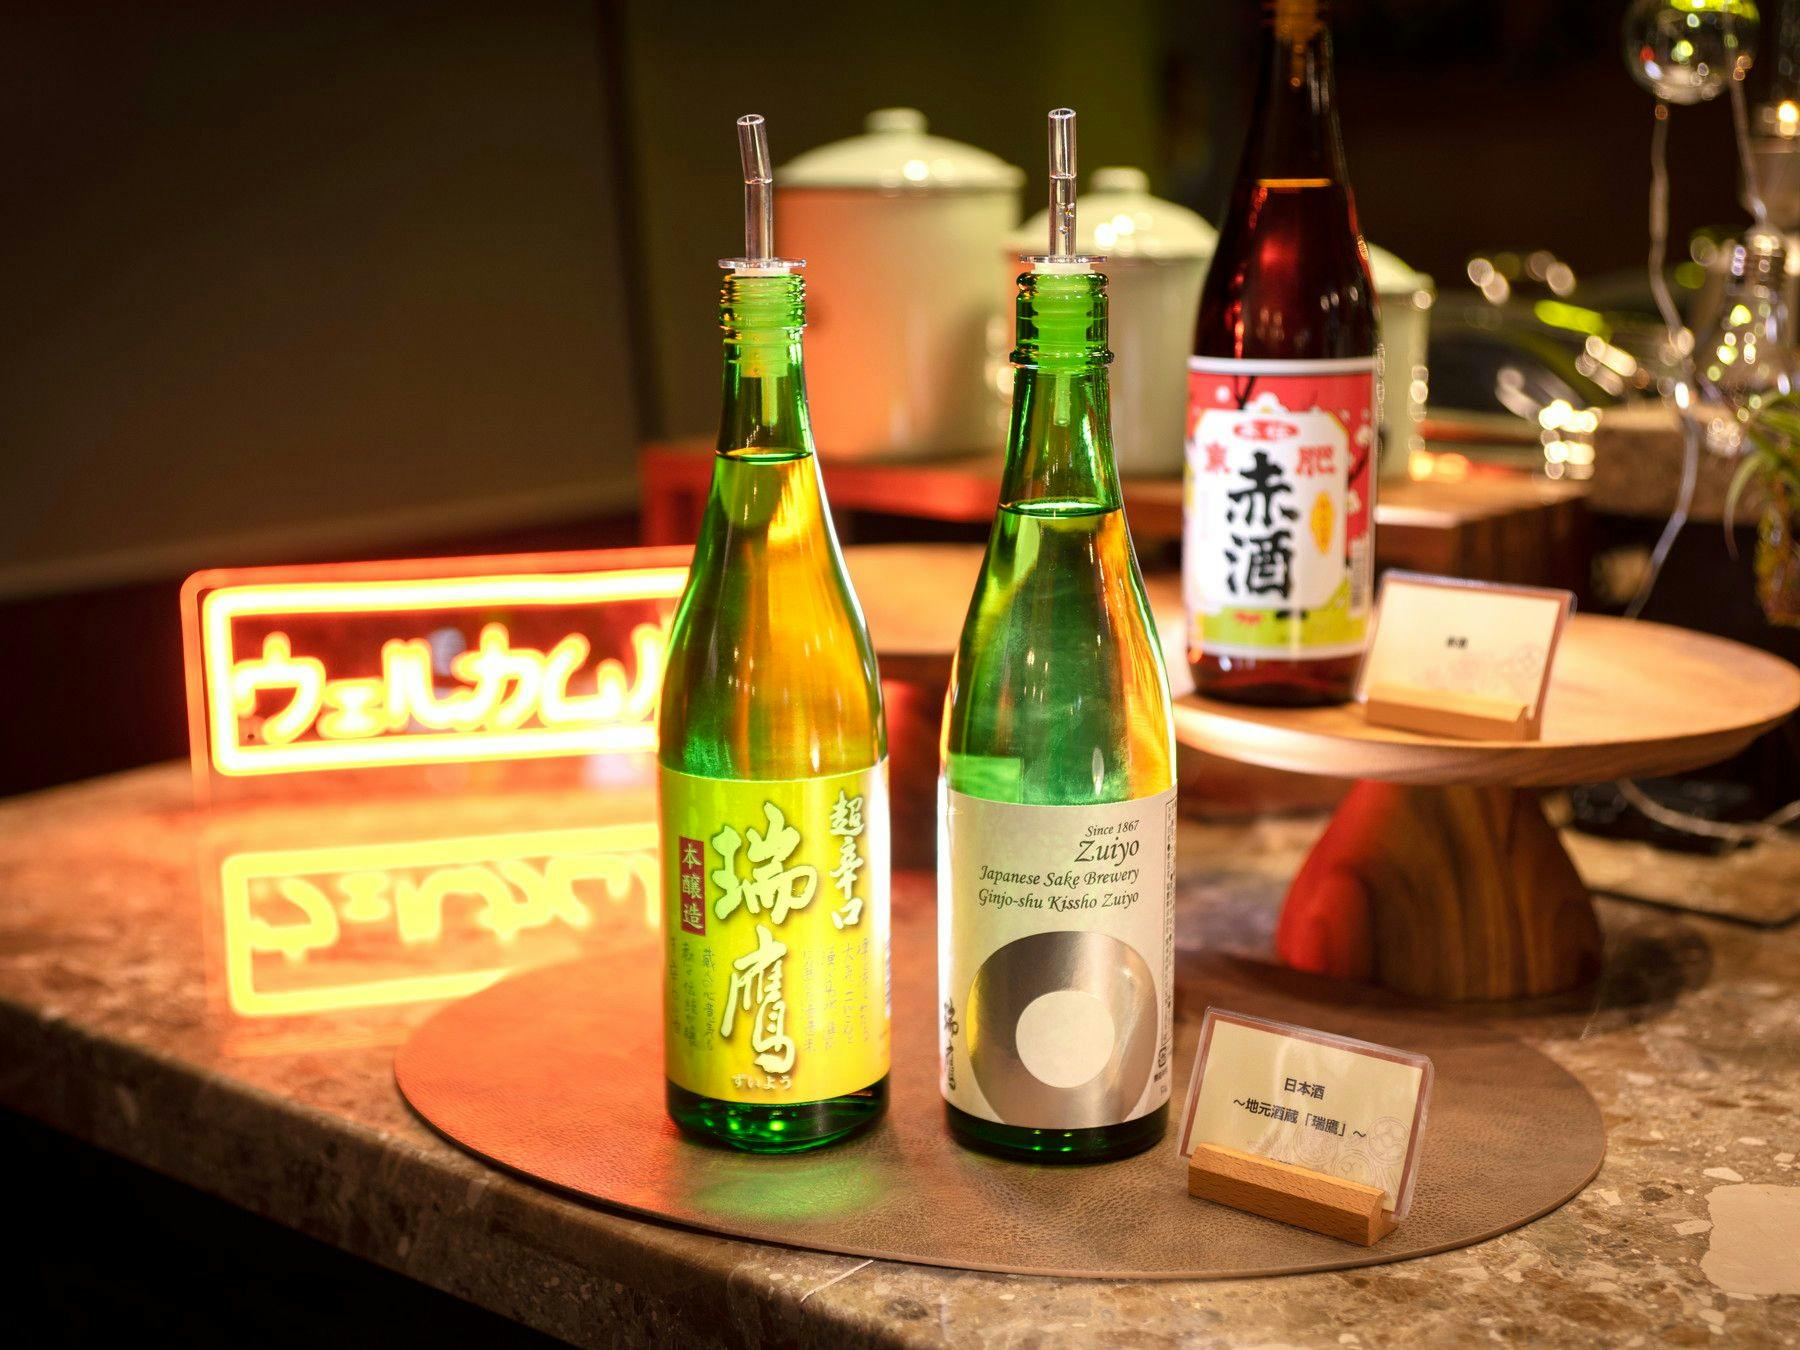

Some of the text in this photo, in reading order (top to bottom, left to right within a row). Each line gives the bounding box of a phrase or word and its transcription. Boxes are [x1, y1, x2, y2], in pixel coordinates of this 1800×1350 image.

[1225, 450, 1298, 598] 赤酒
[1085, 820, 1139, 837] Since 1867
[829, 789, 864, 930] 超辛口
[1074, 836, 1139, 866] Zuiyo
[978, 865, 1139, 889] Japanese Sake Brewery
[978, 889, 1139, 912] Ginjo-shu Kissho Zuiyo
[1284, 1077, 1325, 1100] 日本酒
